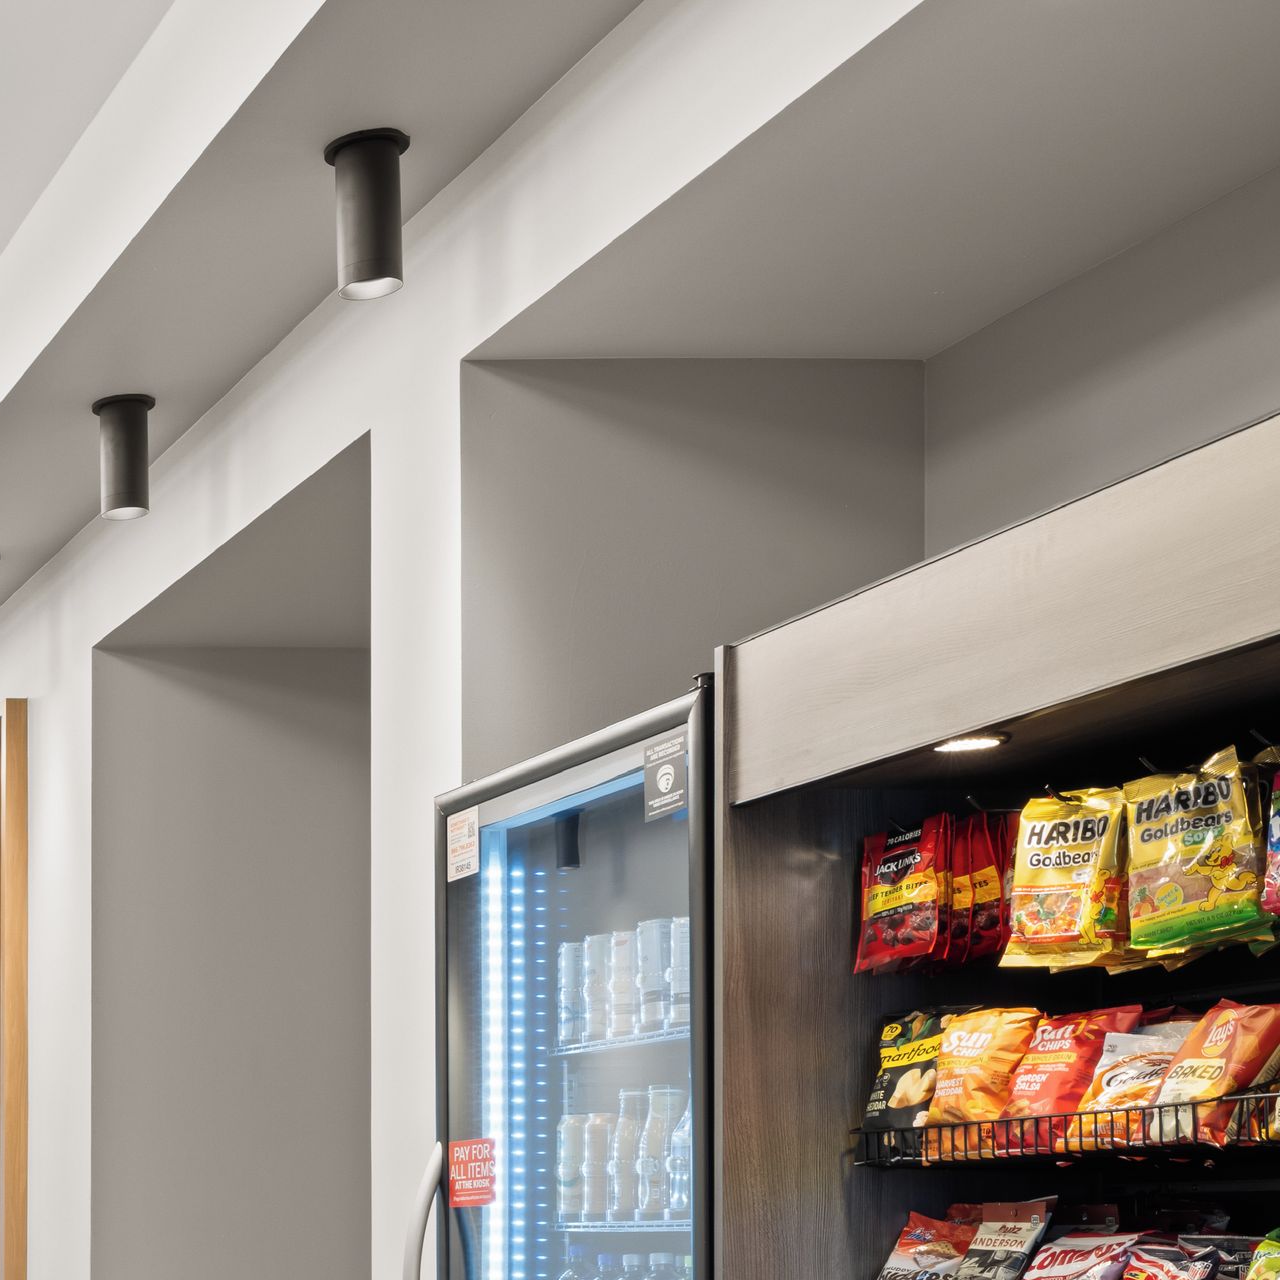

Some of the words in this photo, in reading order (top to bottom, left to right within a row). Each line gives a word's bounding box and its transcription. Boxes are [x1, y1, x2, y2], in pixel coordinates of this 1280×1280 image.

[1135, 776, 1232, 825] HARIBO
[894, 829, 922, 844] CALORIES
[1026, 815, 1109, 846] HARIBO
[1140, 811, 1233, 844] Goldbears
[874, 861, 898, 877] JACK
[897, 852, 922, 870] LINK'S
[1029, 851, 1098, 868] Godbear
[880, 886, 905, 899] TENDER
[941, 1031, 993, 1054] Sun
[1029, 1025, 1076, 1047] Sun
[1203, 1019, 1234, 1048] Lay's
[952, 1046, 986, 1057] CHIP
[1037, 1039, 1072, 1051] CHIPS
[1168, 1065, 1224, 1081] BAKED
[454, 1145, 470, 1162] PAY
[472, 1143, 490, 1160] FOR
[450, 1164, 467, 1180] ALL
[467, 1160, 495, 1178] ITEMS
[455, 1181, 463, 1190] AT
[462, 1180, 473, 1189] THE
[473, 1178, 490, 1189] KIOSK
[972, 1237, 1026, 1249] ANDERSON
